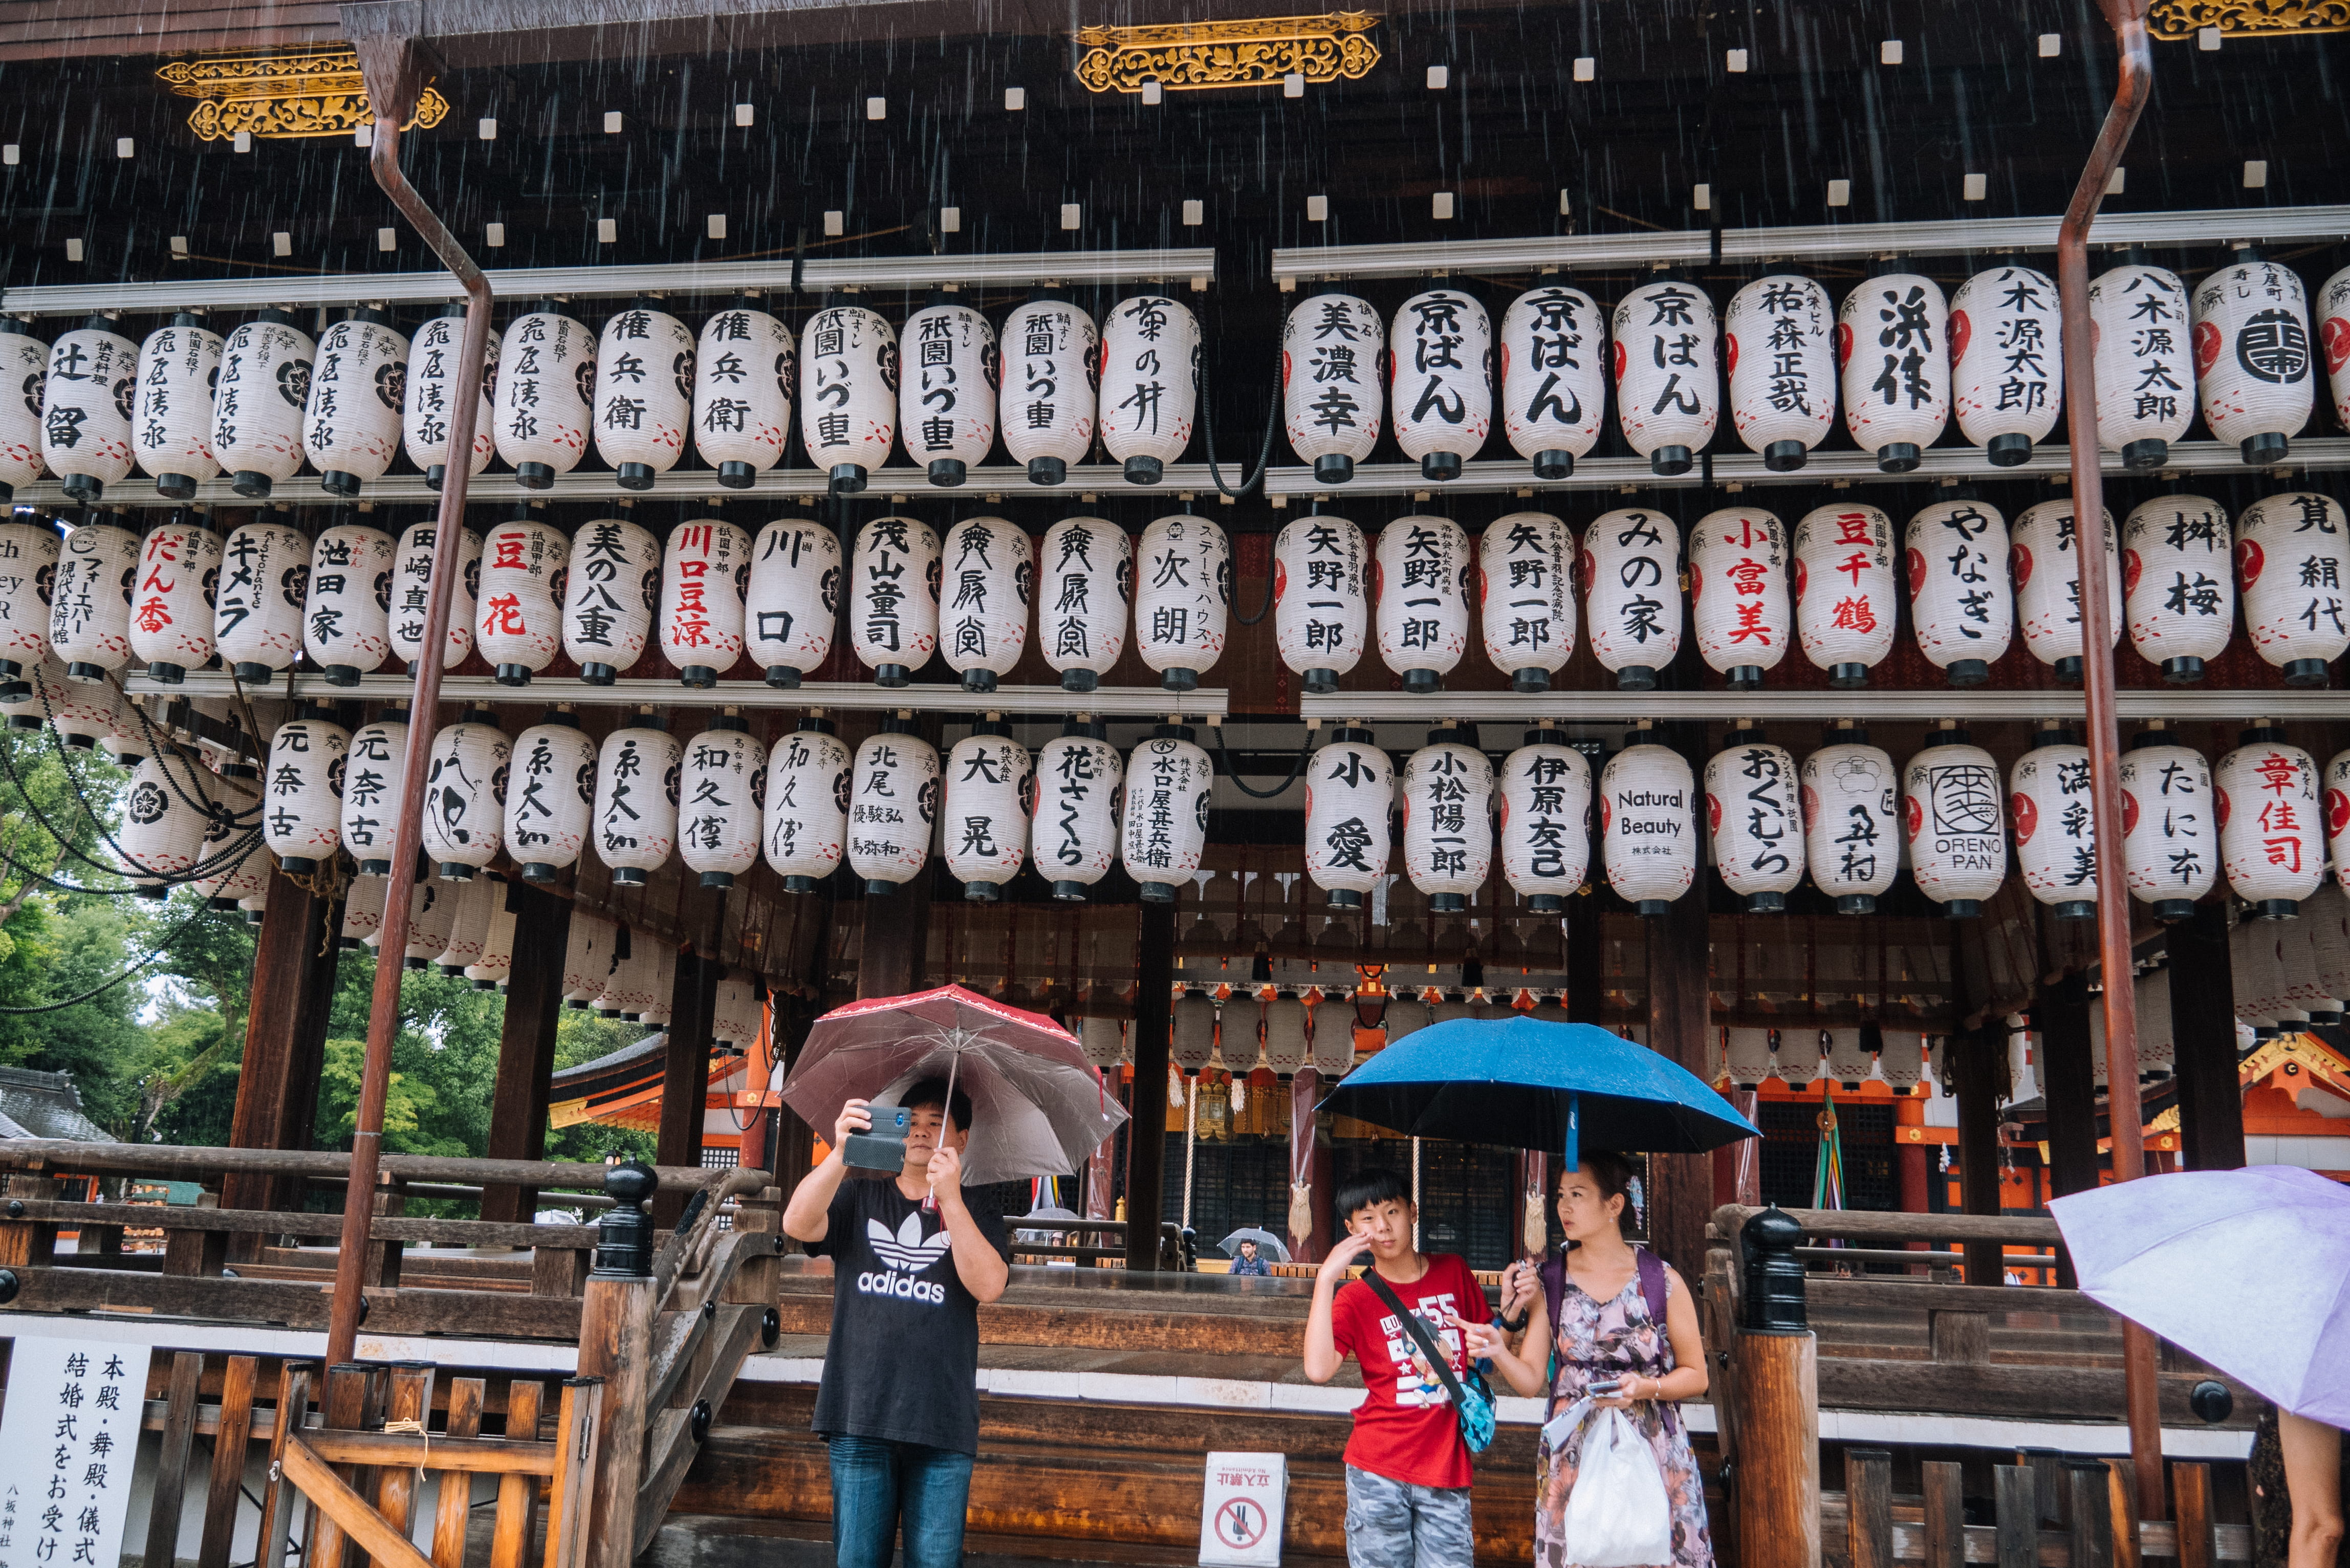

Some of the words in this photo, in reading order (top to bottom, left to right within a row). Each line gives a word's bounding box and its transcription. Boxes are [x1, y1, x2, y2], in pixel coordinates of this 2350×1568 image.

[1356, 300, 1374, 338] 懐石
[1804, 281, 1824, 337] 大栄ビル
[2232, 268, 2252, 299] 寿し
[2260, 262, 2284, 301] 木屋町
[46, 342, 91, 449] 辻留
[91, 339, 115, 386] 懐石料理
[1119, 298, 1173, 436] 菊の井
[1309, 300, 1361, 437] 美濃幸
[1409, 292, 1468, 424] 京ばん
[1524, 288, 1585, 425] 京ばん
[1643, 287, 1702, 416] 京ばん
[1758, 283, 1812, 417] 祐森正哉
[1995, 268, 2050, 416] 八木源太郎
[2123, 272, 2183, 423] 八木源太郎
[53, 561, 76, 646] 現代美術館
[217, 532, 259, 638] キメラ
[310, 539, 352, 645] 池田家
[350, 534, 368, 569] ぎおん
[482, 532, 527, 637] 豆花
[575, 523, 633, 647] 美の八重
[671, 525, 713, 648] 川口豆涼
[756, 530, 803, 644] 川口
[865, 519, 910, 652] 茂山童司
[1152, 548, 1191, 645] 次朗
[1193, 525, 1213, 641] ステーキハウス
[1303, 523, 1346, 655] 矢野一郎
[1401, 525, 1442, 652] 矢野一郎
[1505, 522, 1551, 652] 矢野一郎
[1618, 513, 1665, 645] みの家
[1724, 518, 1772, 646] 小富美
[1831, 512, 1877, 635] 豆千鶴
[2289, 495, 2347, 636] 筧絹代
[268, 725, 310, 838] 元奈古
[347, 729, 390, 847] 元奈古
[732, 737, 745, 775] 高台寺
[816, 737, 830, 770] 高台寺
[861, 745, 899, 798] 北尾
[958, 747, 1002, 857] 大晃
[998, 745, 1012, 783] 株式会社
[1055, 745, 1095, 866] 花さくら
[1177, 756, 1191, 793] 株式会社
[1618, 790, 1683, 810] Natural
[1144, 755, 1179, 868] 水口屋甚兵衛
[1325, 751, 1376, 872] 小愛
[1427, 751, 1471, 879] 小松陽一郎
[1523, 755, 1571, 878] 伊原友己
[1621, 816, 1682, 838] Beauty
[1631, 845, 1672, 856] 株式会社
[1740, 748, 1791, 875] おくむら
[1935, 838, 2001, 853] ORENO
[1952, 854, 1992, 870] PAN
[2159, 760, 2202, 885] たに本
[2253, 752, 2302, 874] 章佳司
[858, 1270, 945, 1304] adidas
[0, 1483, 19, 1547] 八坂神社
[37, 1352, 90, 1568] 結婚式をお受け
[72, 1354, 125, 1566] 本殿・舞殿・儀式
[1217, 1473, 1270, 1487] 立入禁止
